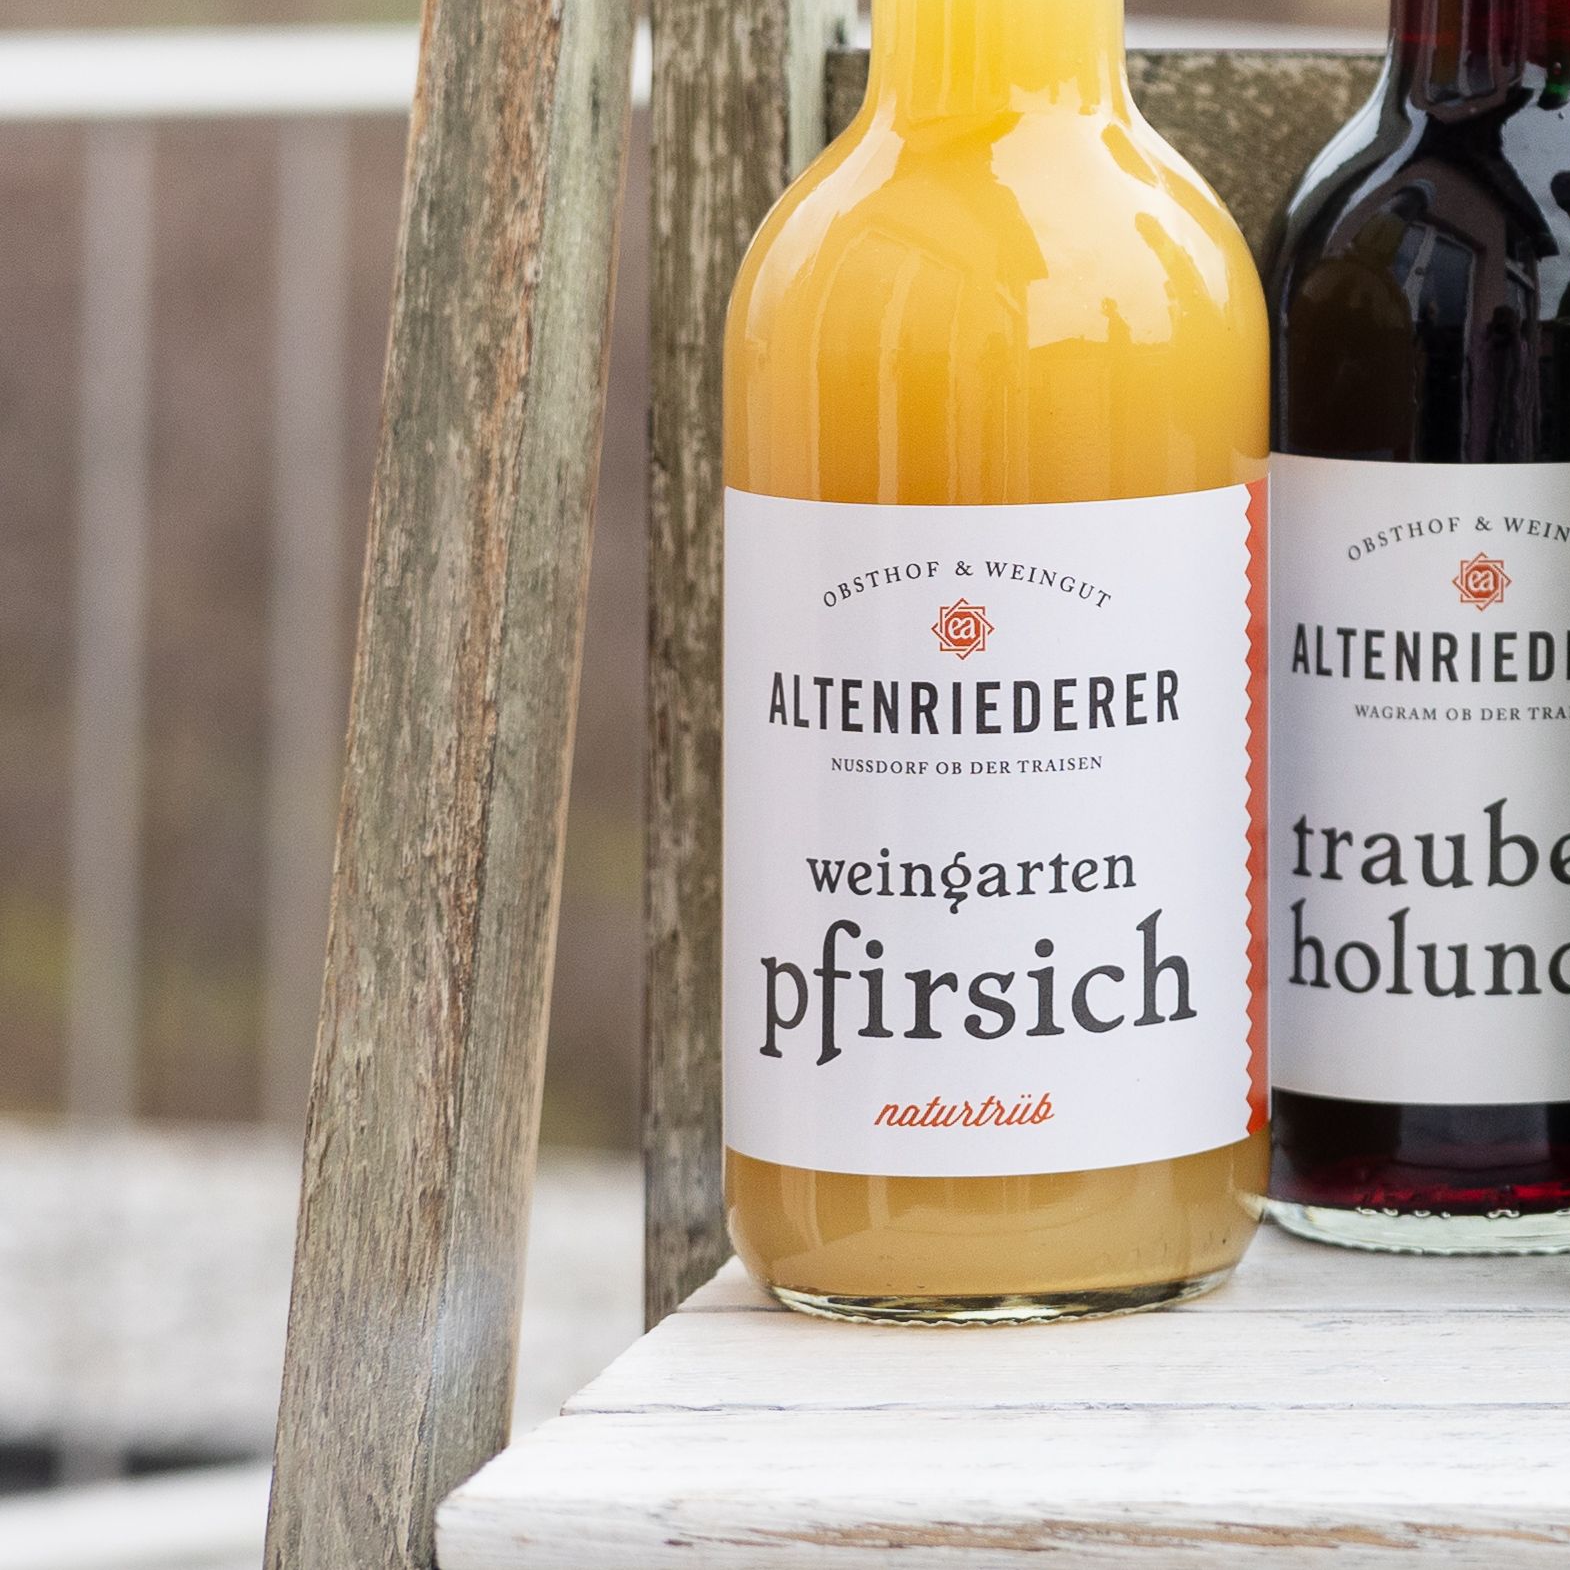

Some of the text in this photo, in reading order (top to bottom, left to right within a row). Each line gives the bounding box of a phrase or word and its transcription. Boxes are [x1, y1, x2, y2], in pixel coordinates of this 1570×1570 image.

[1348, 517, 1464, 563] OBSTHOF
[1475, 517, 1491, 531] &
[824, 561, 1111, 611] OBSTHOF & WEINGUT
[769, 670, 1179, 734] ALTENRIEDERER
[1355, 705, 1436, 720] WAGRAM
[1446, 708, 1471, 720] OB
[1481, 708, 1520, 720] DER
[832, 756, 1101, 774] NUSSDORF OB DER TRAISEN
[806, 848, 1136, 914] weingarten
[760, 906, 1197, 1066] pfirsich
[874, 1093, 1054, 1127] naturtrüb
